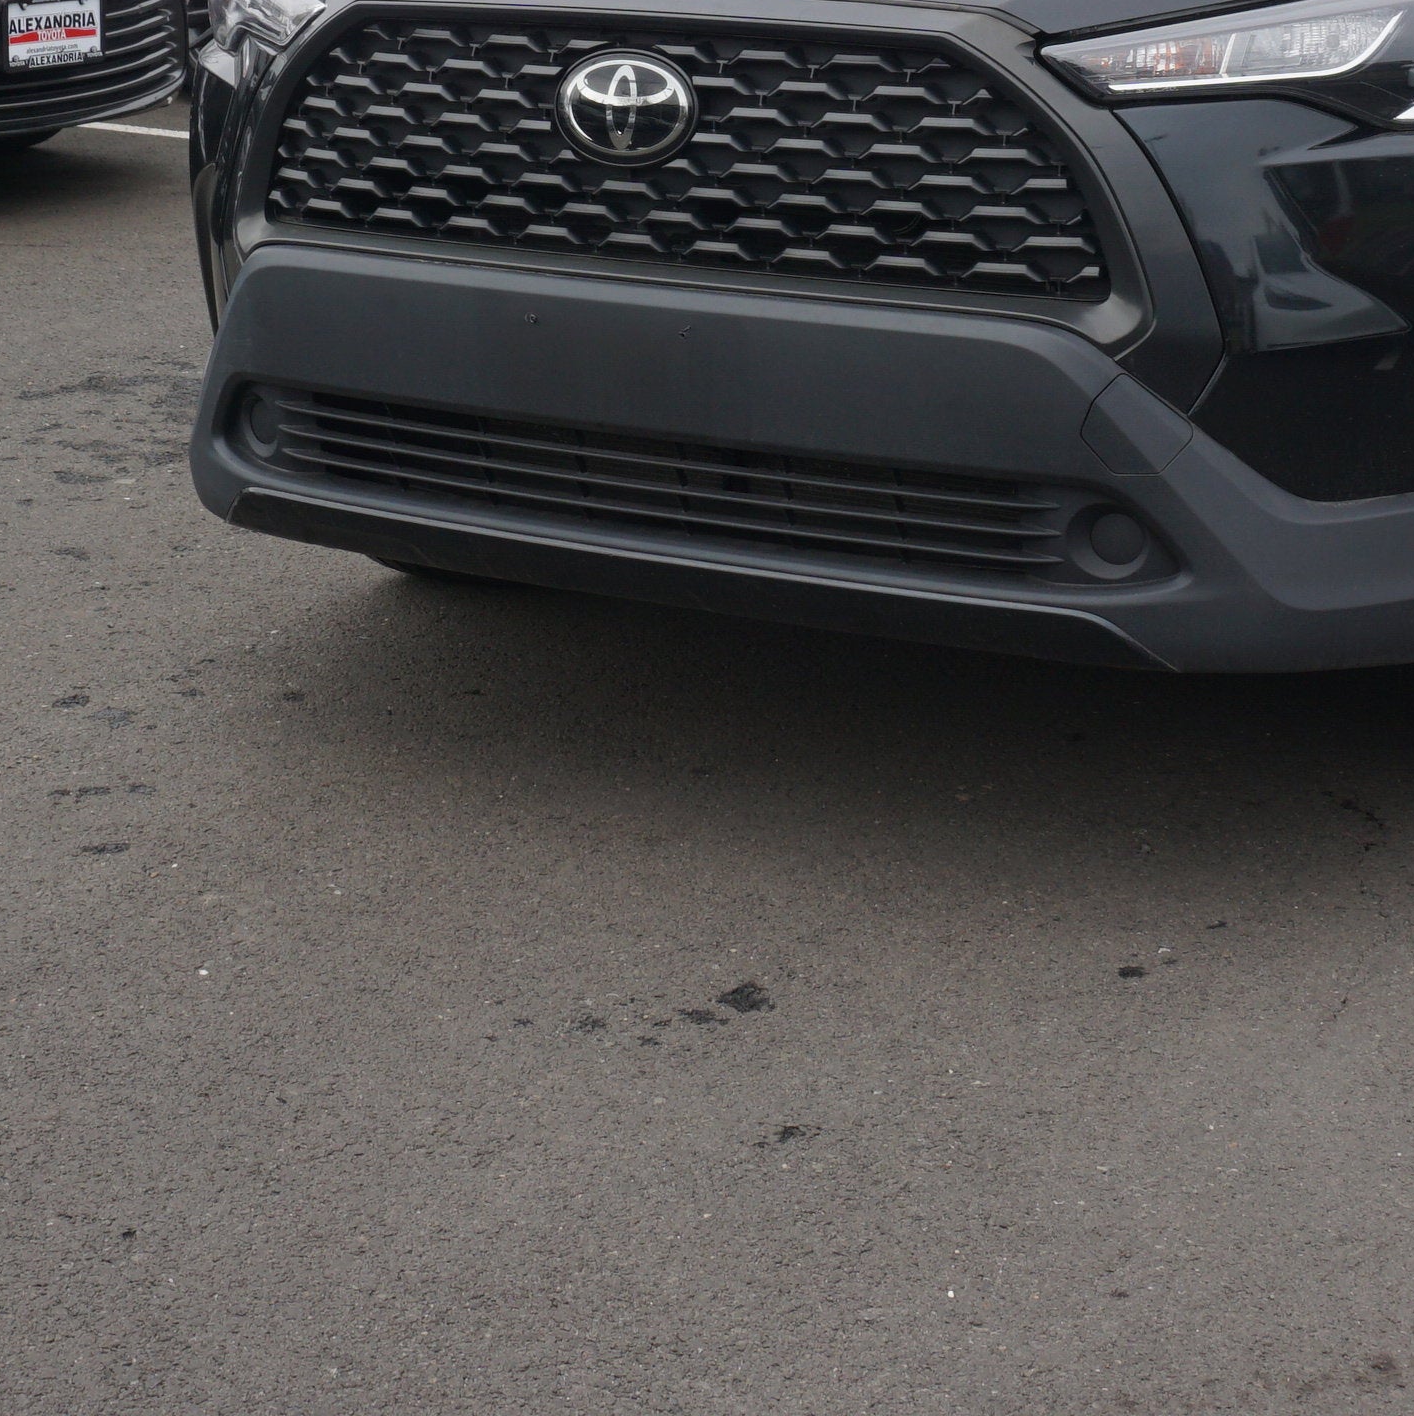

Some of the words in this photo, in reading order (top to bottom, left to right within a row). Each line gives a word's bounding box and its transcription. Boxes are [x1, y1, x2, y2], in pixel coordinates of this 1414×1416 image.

[9, 12, 96, 35] ALEXANDRIA
[37, 28, 67, 42] TOYOTA
[29, 52, 84, 68] ALEXANDRIA
